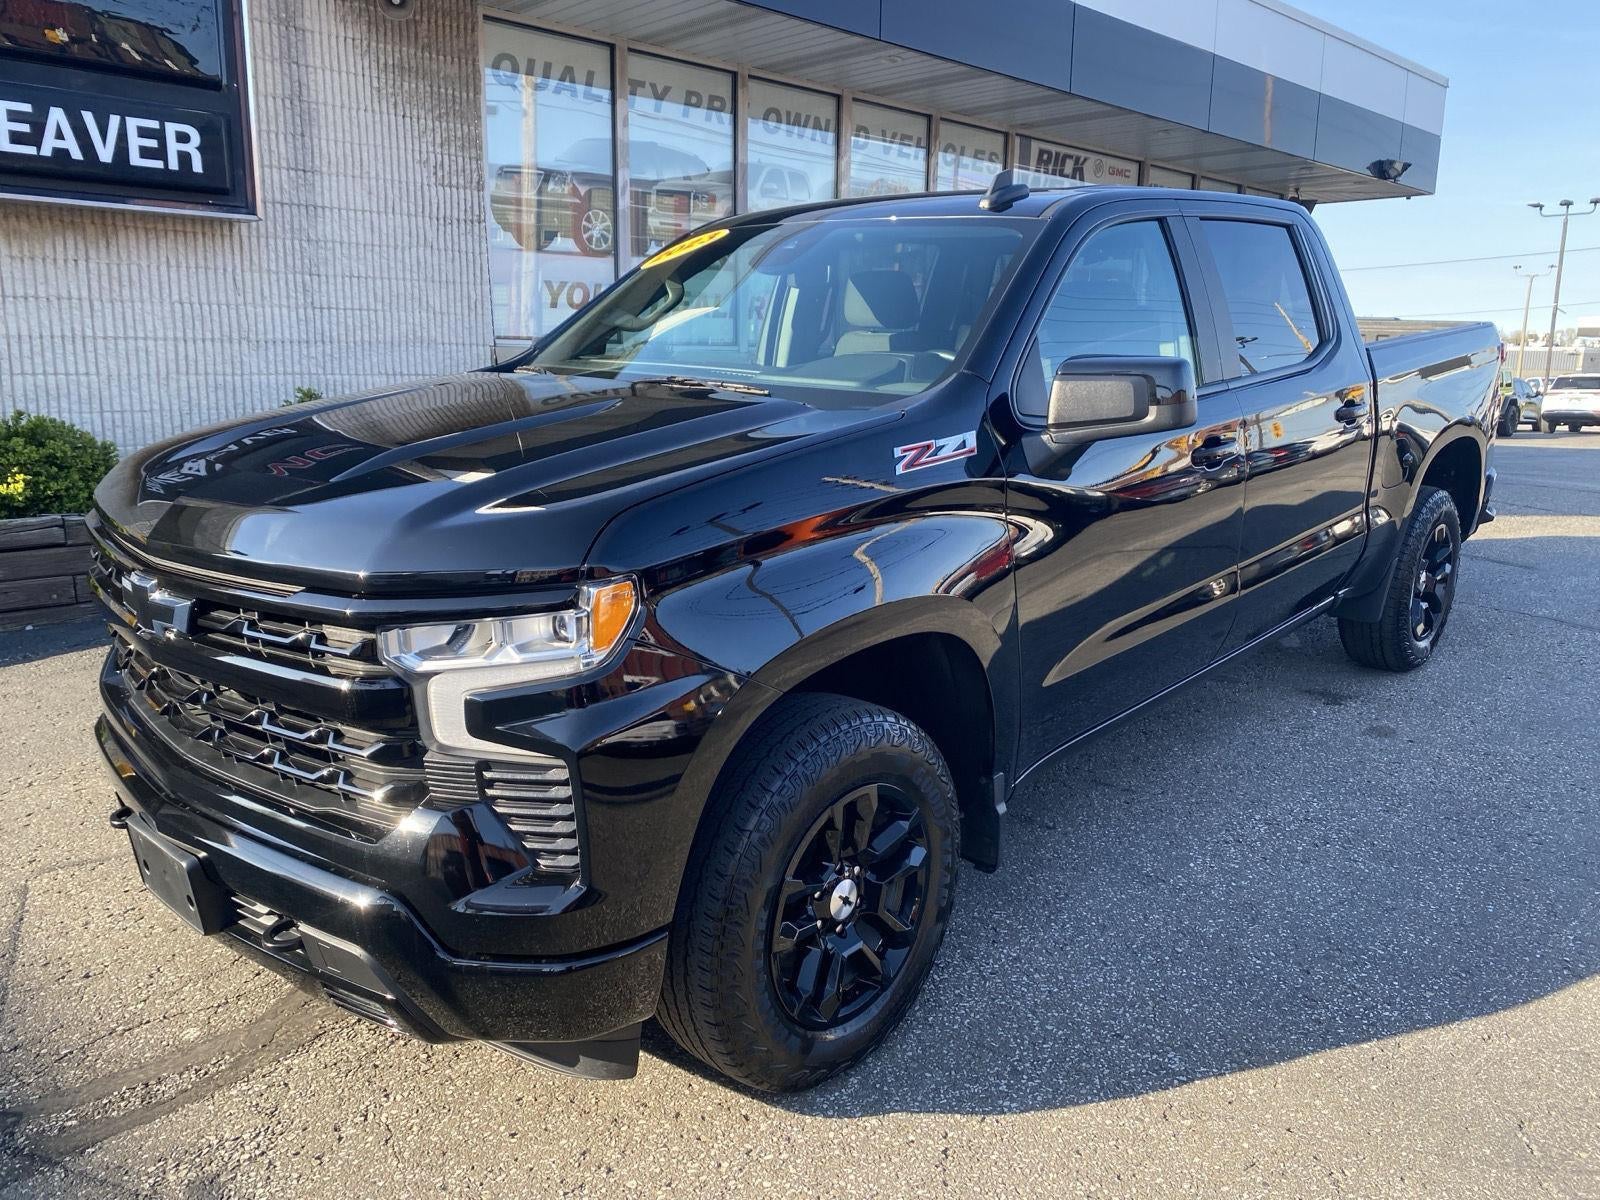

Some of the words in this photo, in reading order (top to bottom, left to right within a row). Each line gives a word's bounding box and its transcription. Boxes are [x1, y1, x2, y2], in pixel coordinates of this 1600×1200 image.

[491, 52, 672, 114] QUALTY
[0, 100, 204, 174] EAVER
[1035, 148, 1089, 181] RICK
[1108, 166, 1131, 178] GMC
[893, 430, 977, 476] Z71
